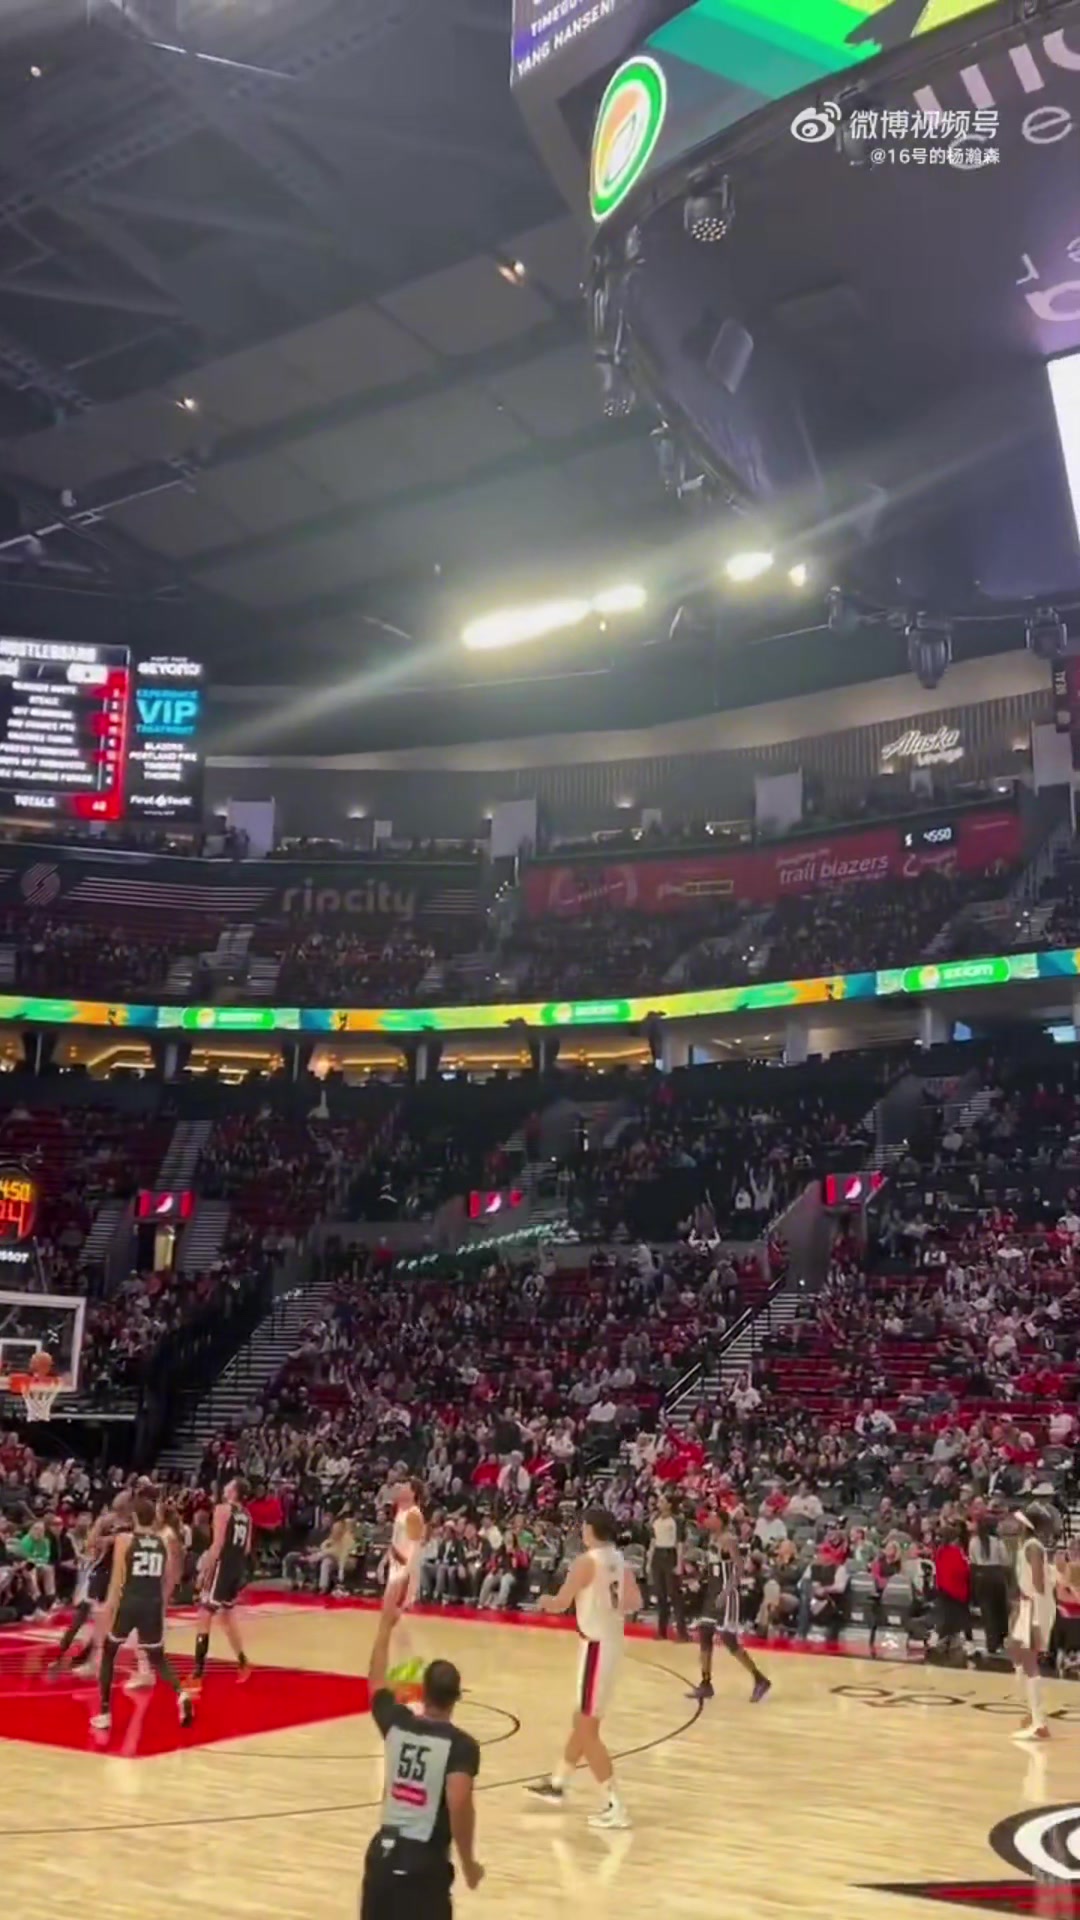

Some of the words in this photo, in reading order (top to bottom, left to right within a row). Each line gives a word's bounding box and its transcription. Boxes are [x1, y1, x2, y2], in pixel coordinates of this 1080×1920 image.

[517, 40, 550, 77] YANG
[137, 699, 198, 724] VIP
[129, 752, 177, 761] PORTLAND
[882, 726, 960, 760] Alaska
[780, 862, 816, 885] trail
[820, 855, 889, 878] blazers
[132, 1551, 164, 1577] 20
[397, 1742, 431, 1782] 55
